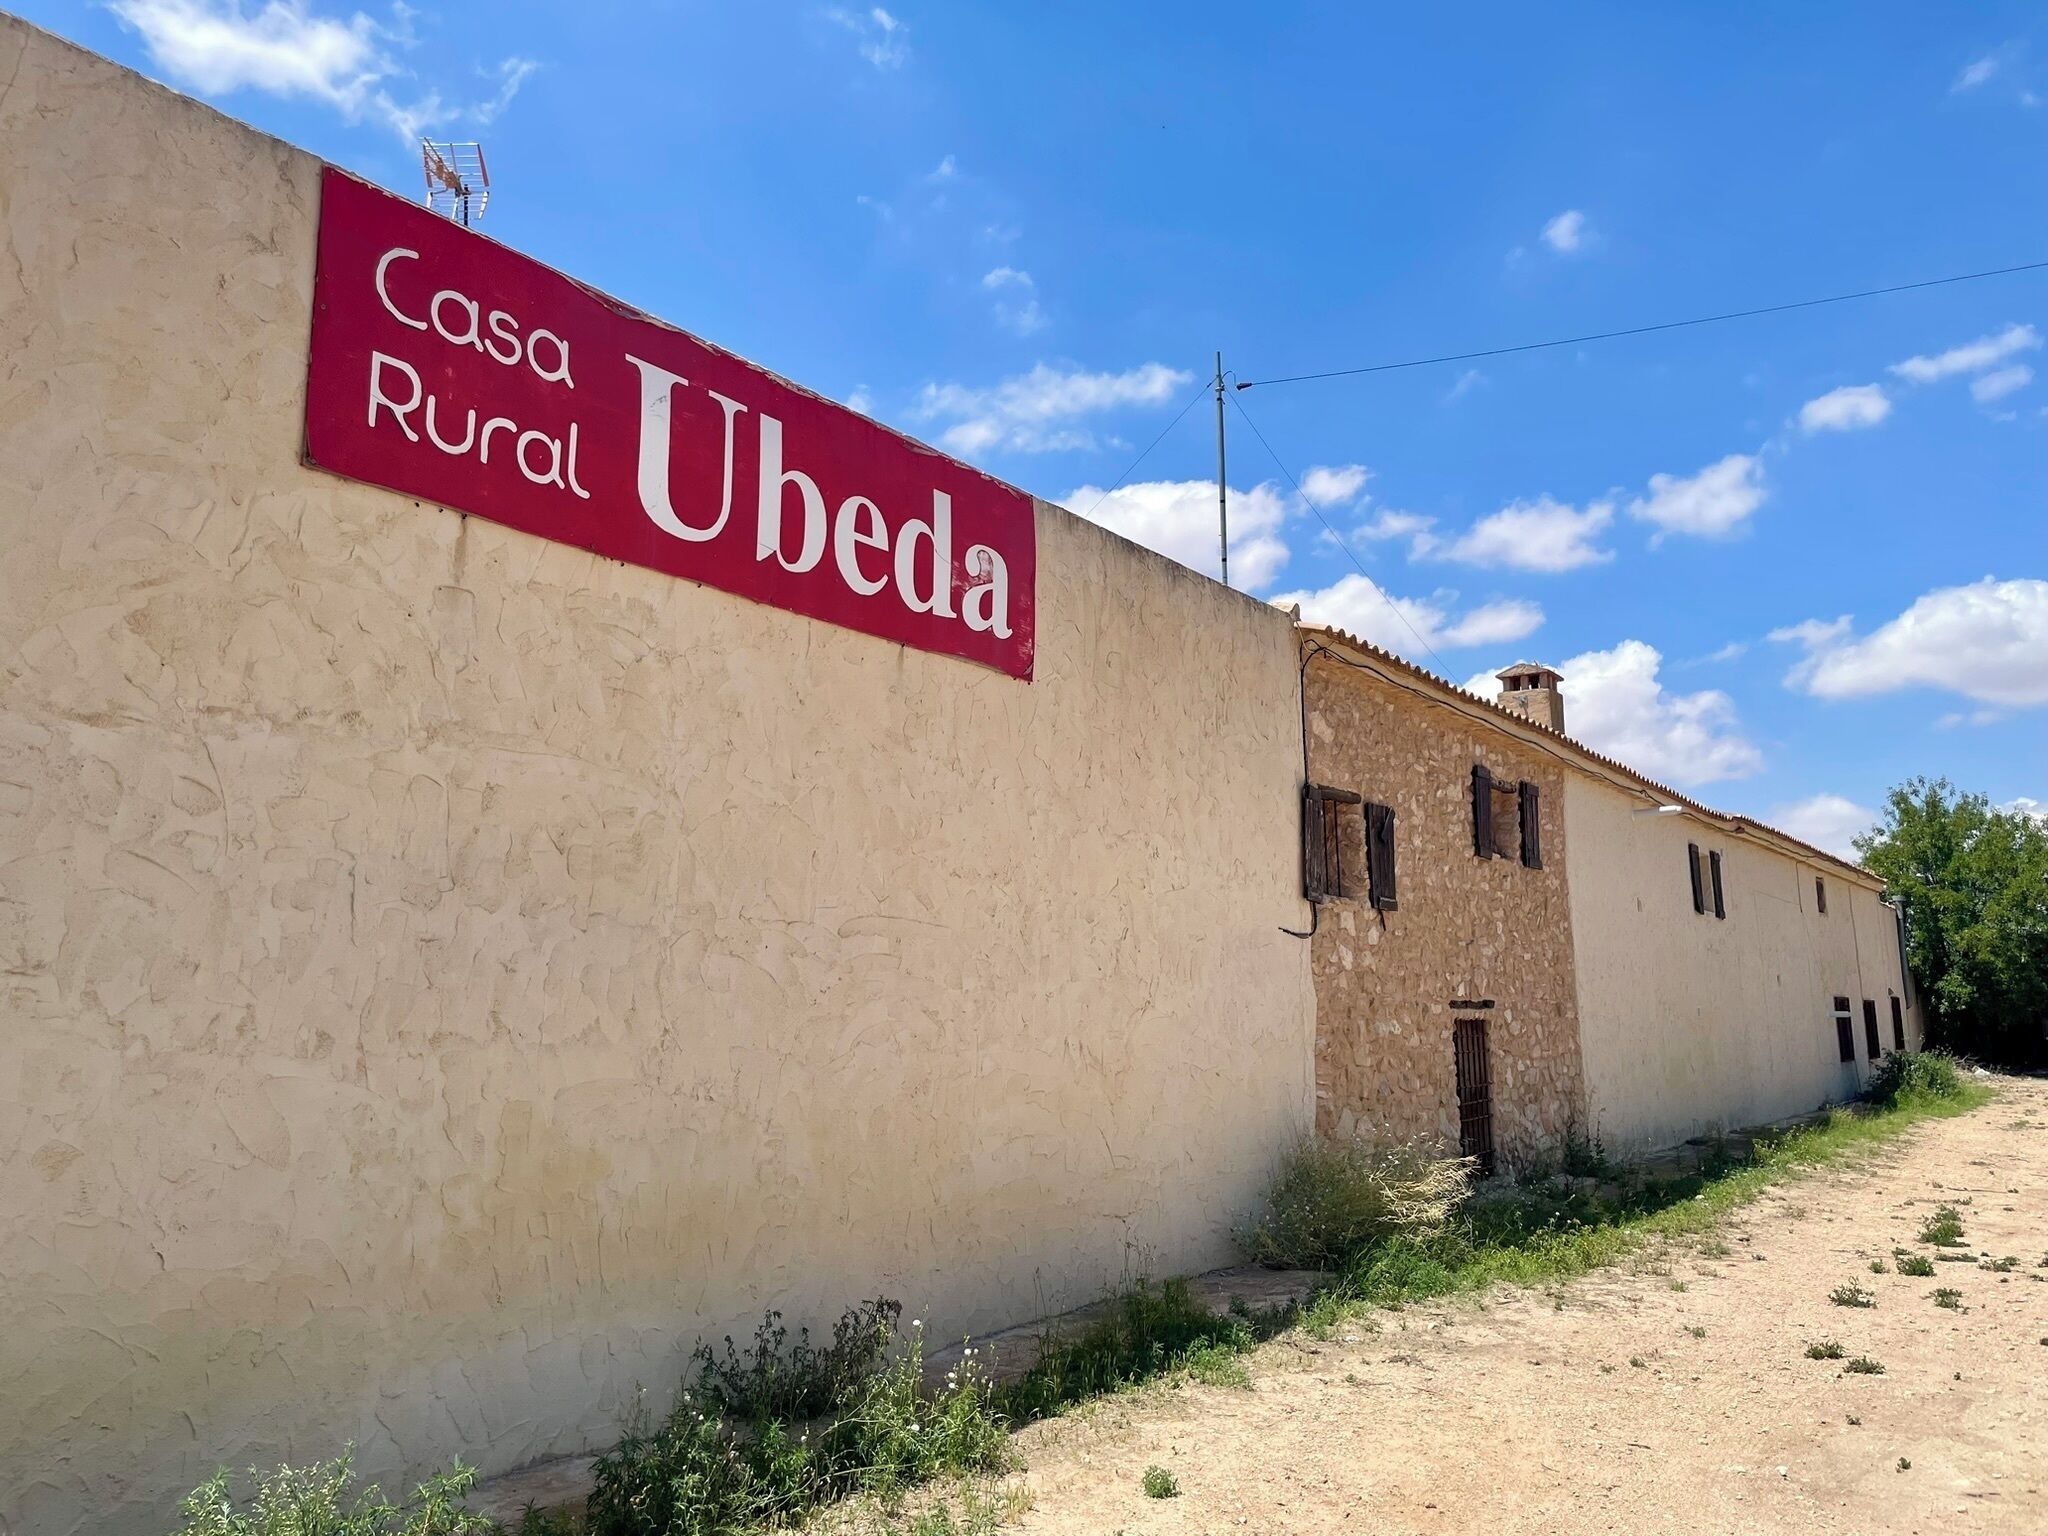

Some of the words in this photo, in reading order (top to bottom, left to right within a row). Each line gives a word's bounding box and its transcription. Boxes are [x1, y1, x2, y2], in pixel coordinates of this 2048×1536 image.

[375, 247, 575, 389] Casa
[368, 350, 591, 499] Rural
[625, 353, 1013, 640] Ubeda
